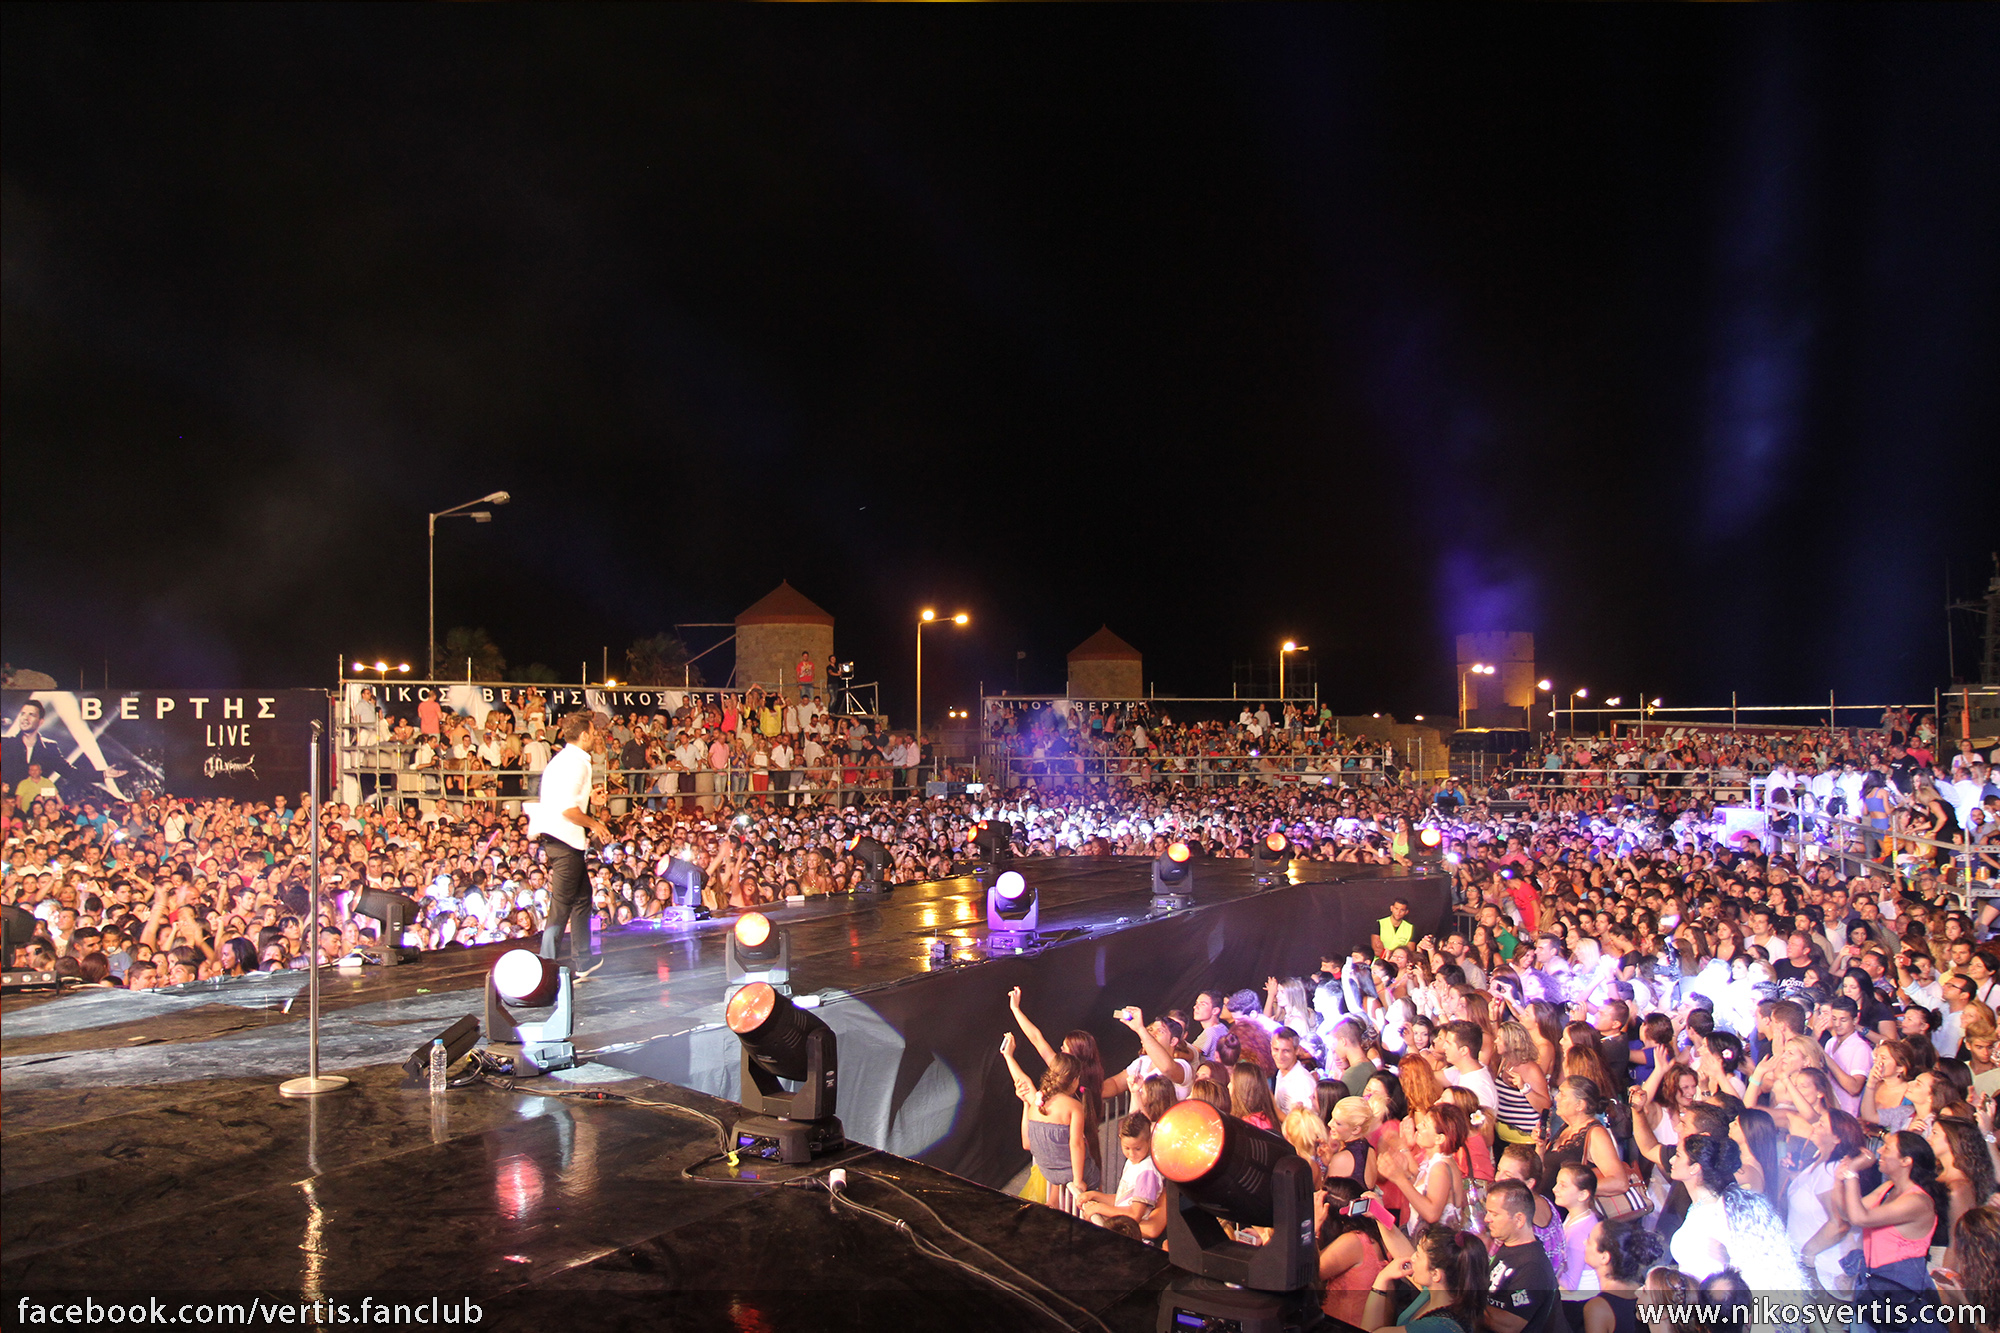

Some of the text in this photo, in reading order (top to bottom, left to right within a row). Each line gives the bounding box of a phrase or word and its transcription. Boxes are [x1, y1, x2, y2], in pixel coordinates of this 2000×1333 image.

[81, 697, 276, 721] ΒΕΡΤΗΣ
[595, 692, 667, 706] ΝΙΚΟΣ
[206, 724, 251, 747] LIVE
